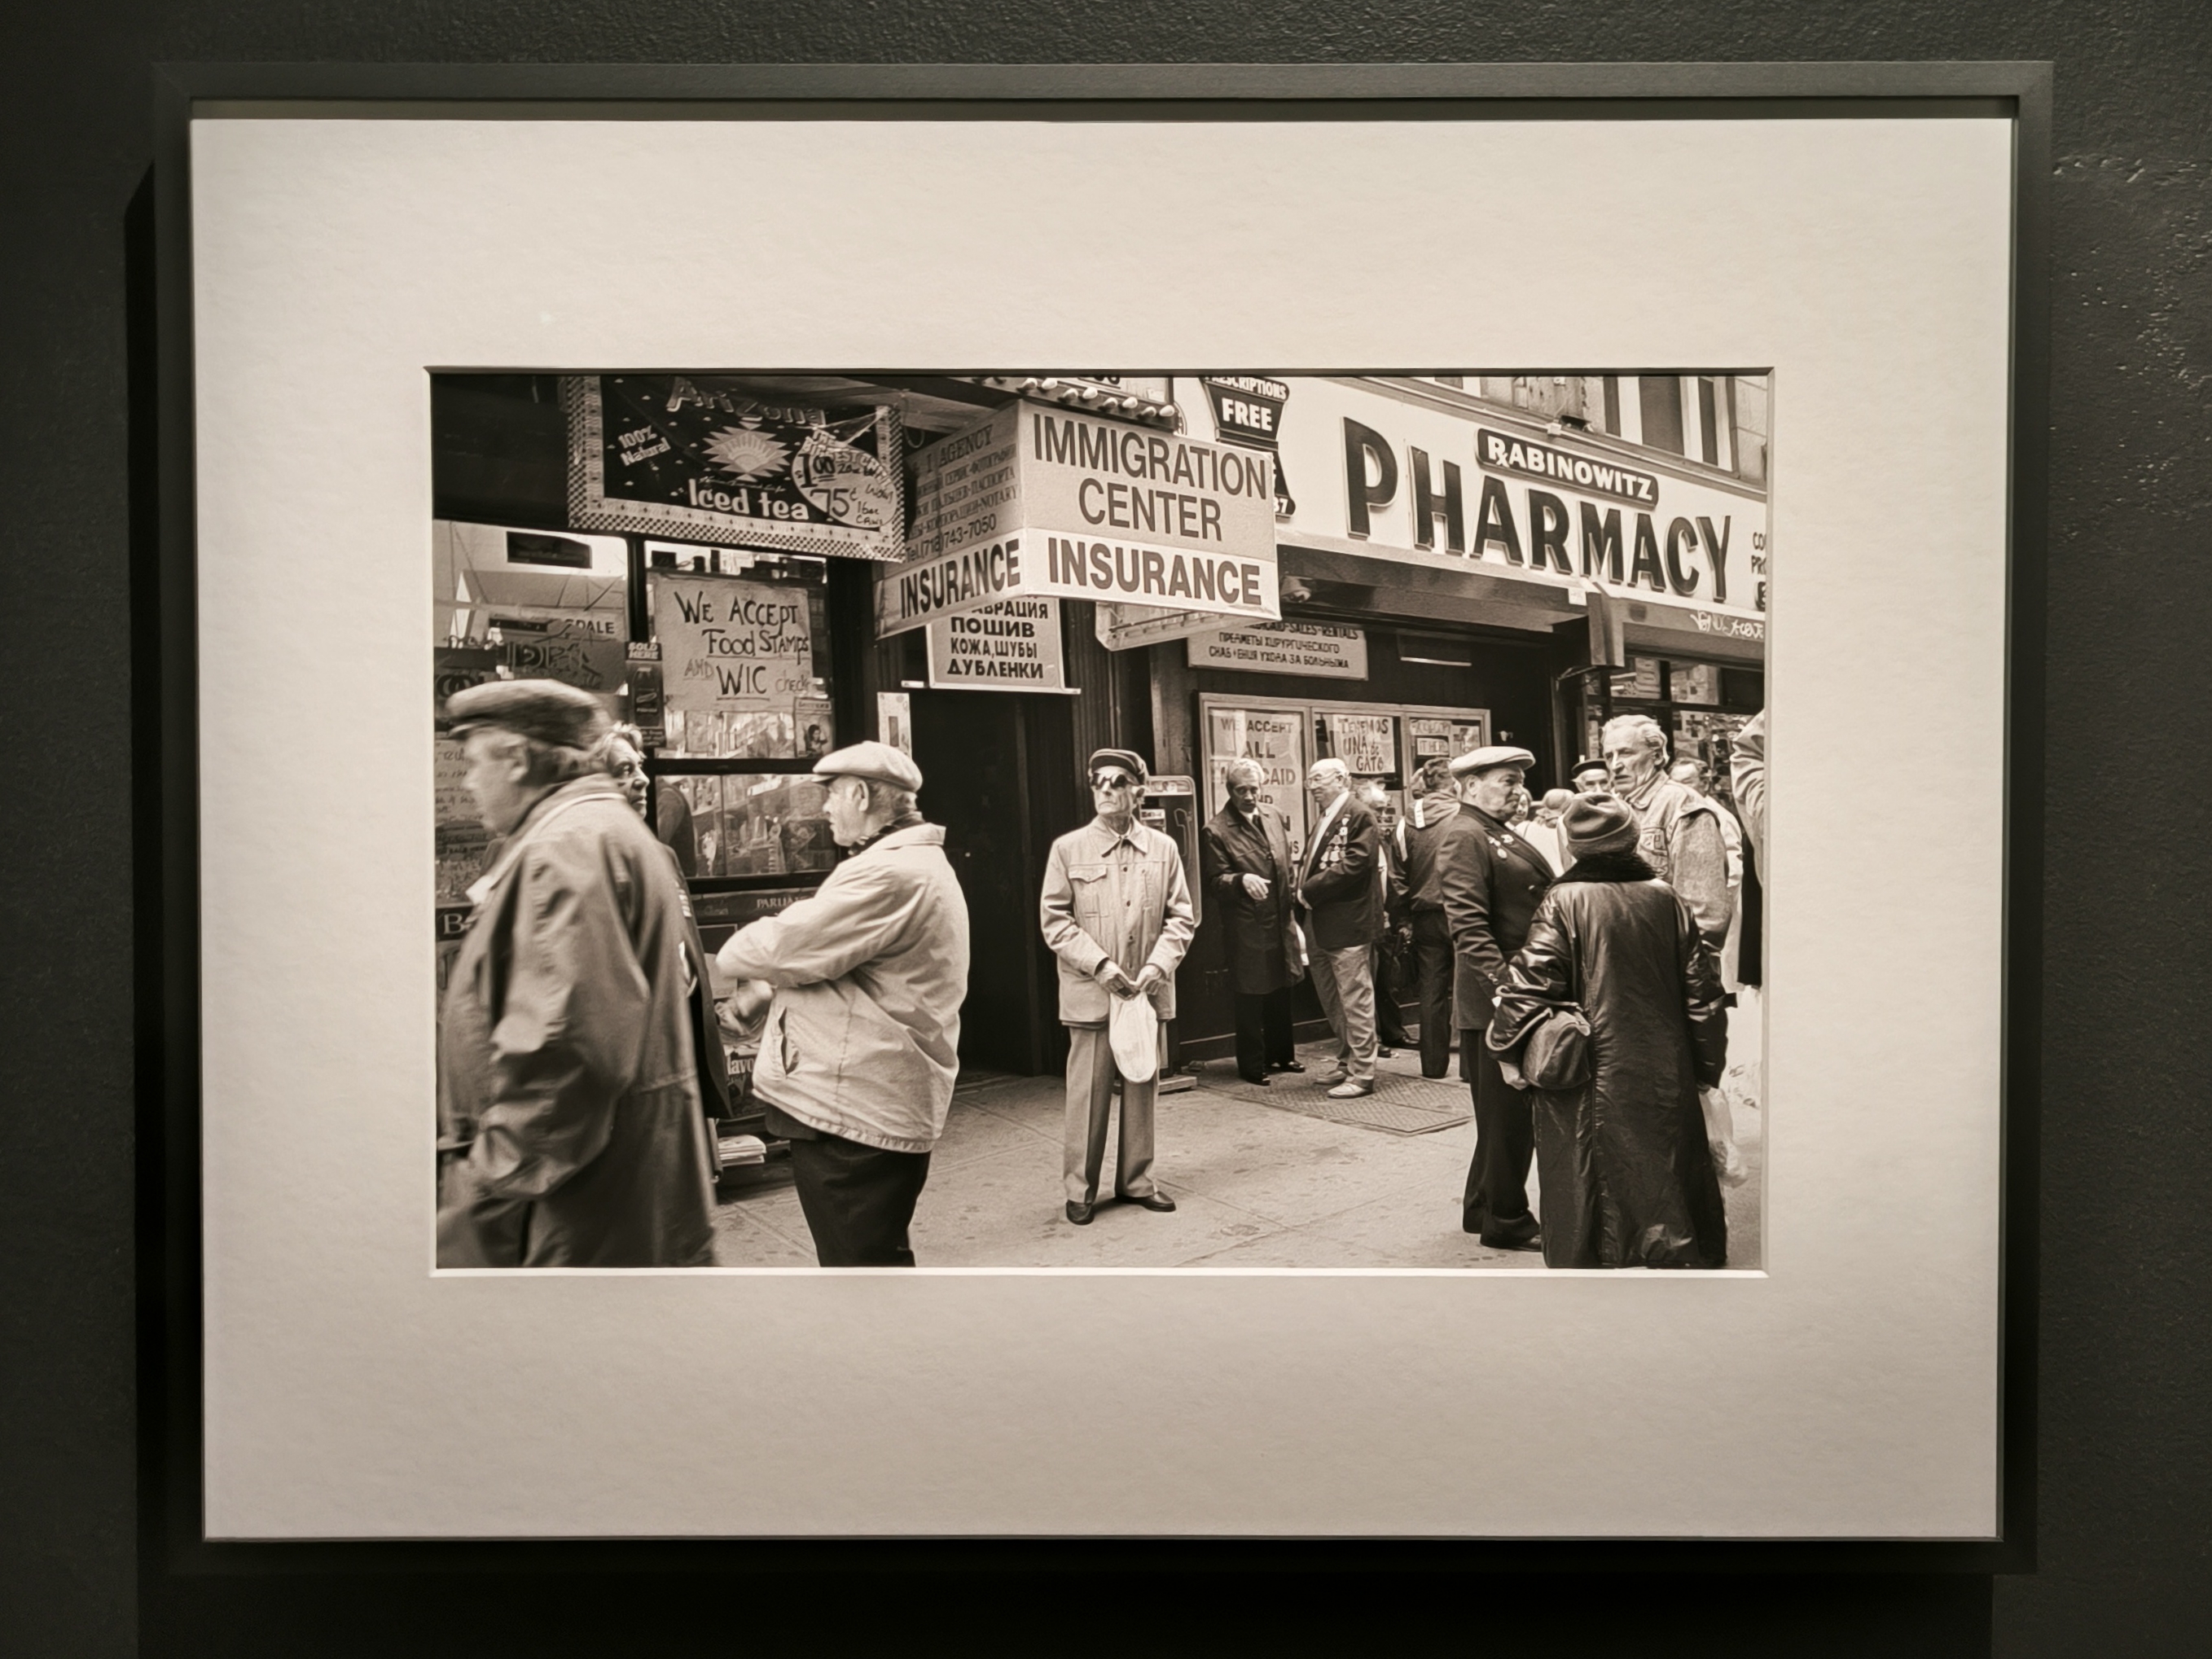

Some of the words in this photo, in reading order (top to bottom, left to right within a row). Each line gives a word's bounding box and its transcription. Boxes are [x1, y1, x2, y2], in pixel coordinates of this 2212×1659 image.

[1206, 376, 1286, 400] ESCRIPTIONS
[1222, 397, 1272, 432] FREE
[938, 424, 993, 468] AGENCY
[1033, 413, 1266, 500] IMMIGRATION
[688, 479, 749, 515] Iced
[758, 492, 809, 520] tea
[1078, 477, 1222, 542] CENTER
[1341, 416, 1731, 602] PHARMACY
[901, 538, 1020, 619] INSURANCE
[1048, 537, 1262, 607] INSURANCE
[950, 617, 1035, 638] ПОШИВ
[628, 642, 658, 651] SOLD
[629, 652, 659, 660] HERE
[947, 659, 1043, 678] ДУБЛЕНКИ
[1247, 719, 1293, 733] ACCEPT
[1241, 741, 1275, 758] ALL
[1344, 735, 1368, 756] UNA
[1355, 756, 1385, 771] GATO
